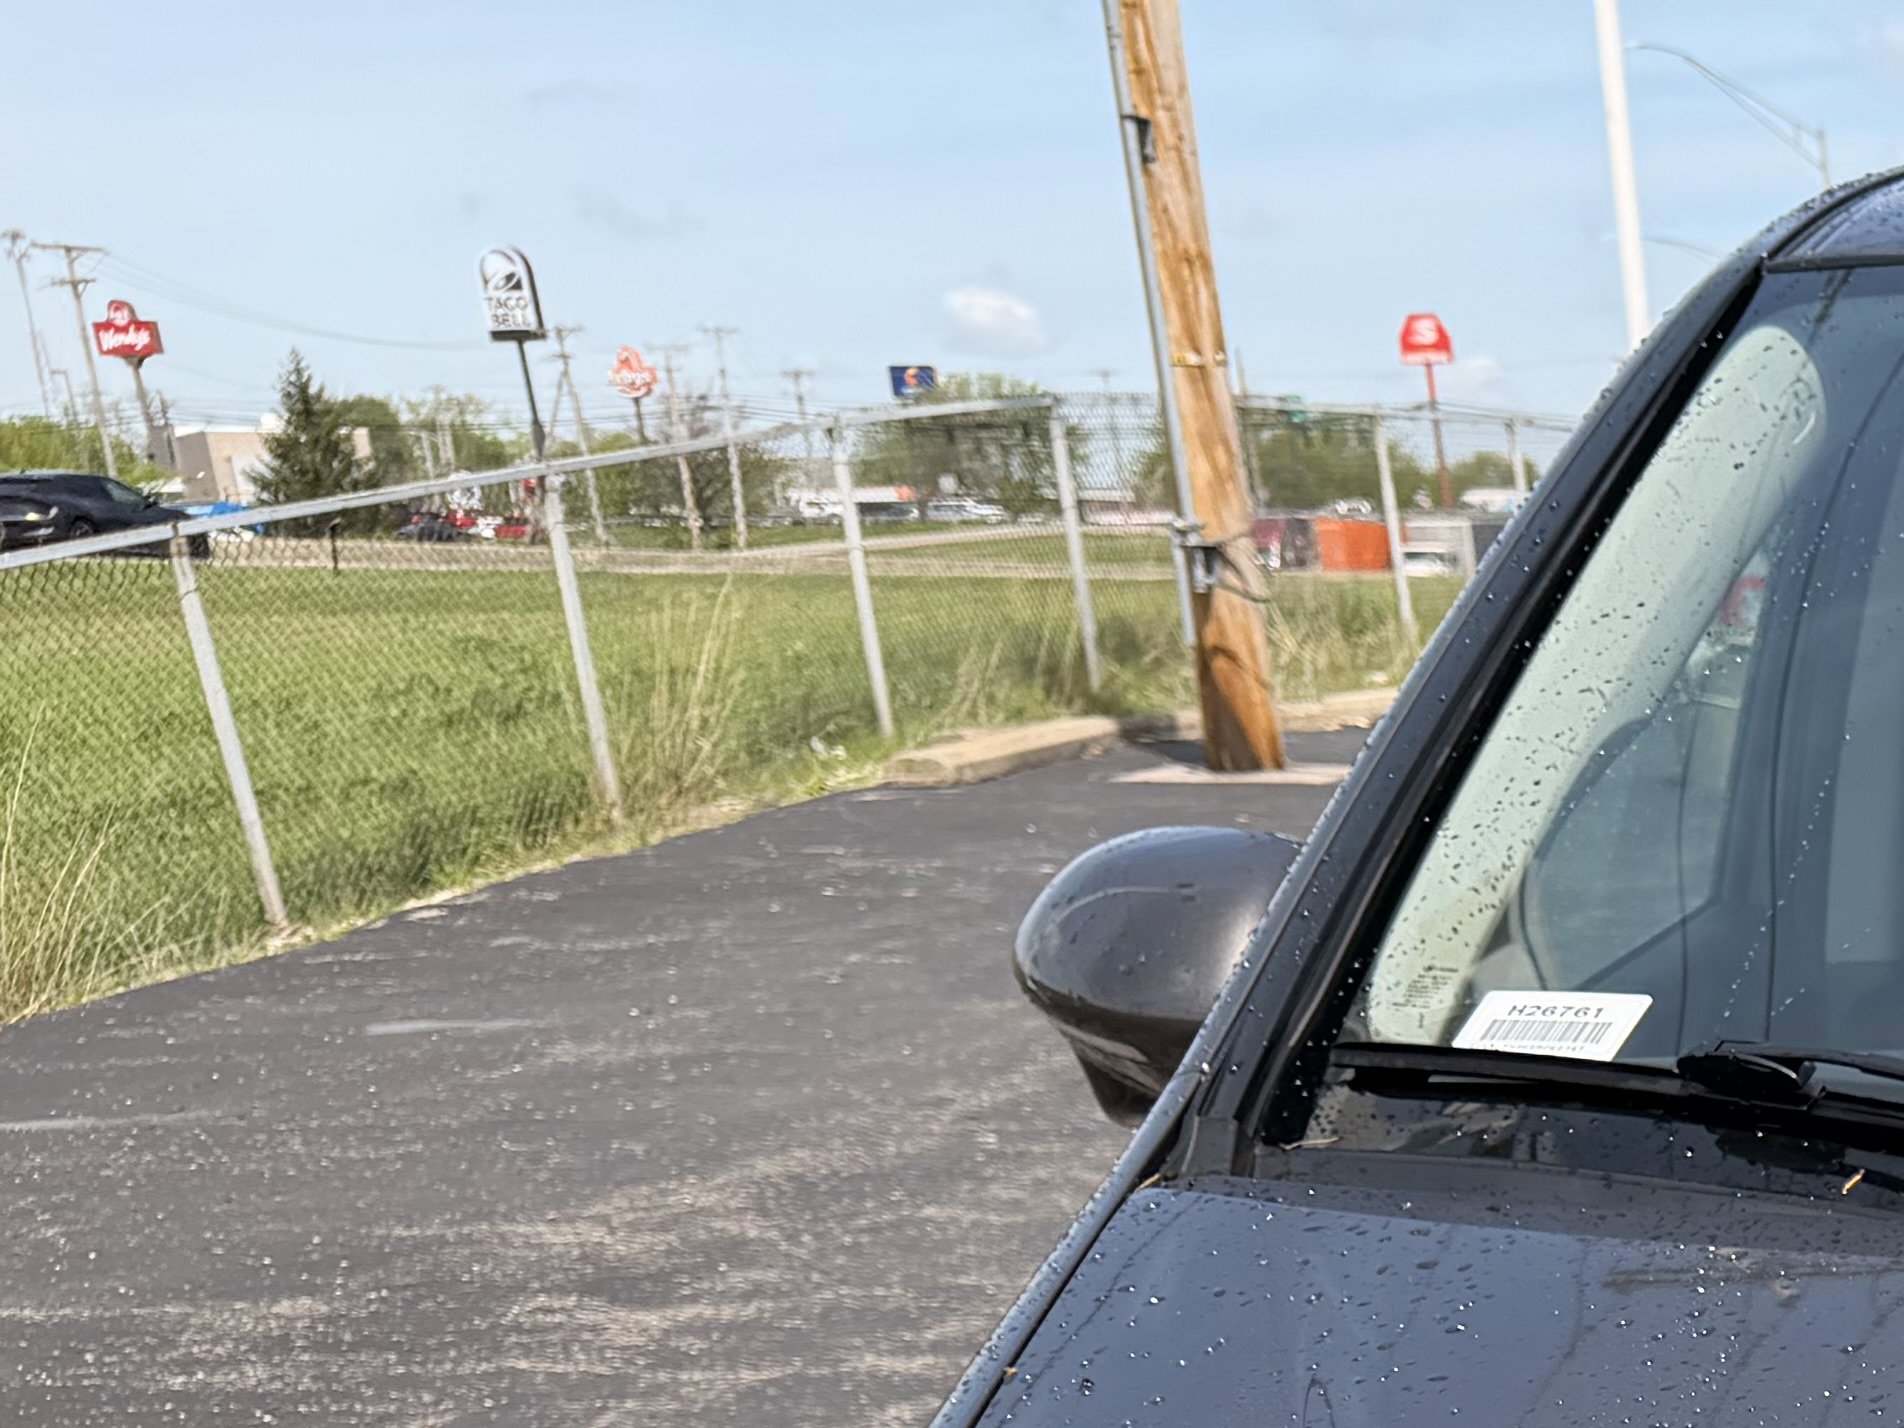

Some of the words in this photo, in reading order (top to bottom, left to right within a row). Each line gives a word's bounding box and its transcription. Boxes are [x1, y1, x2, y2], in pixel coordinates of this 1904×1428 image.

[483, 297, 528, 311] TACO
[491, 313, 531, 327] BELL
[1508, 1005, 1604, 1019] H26761
